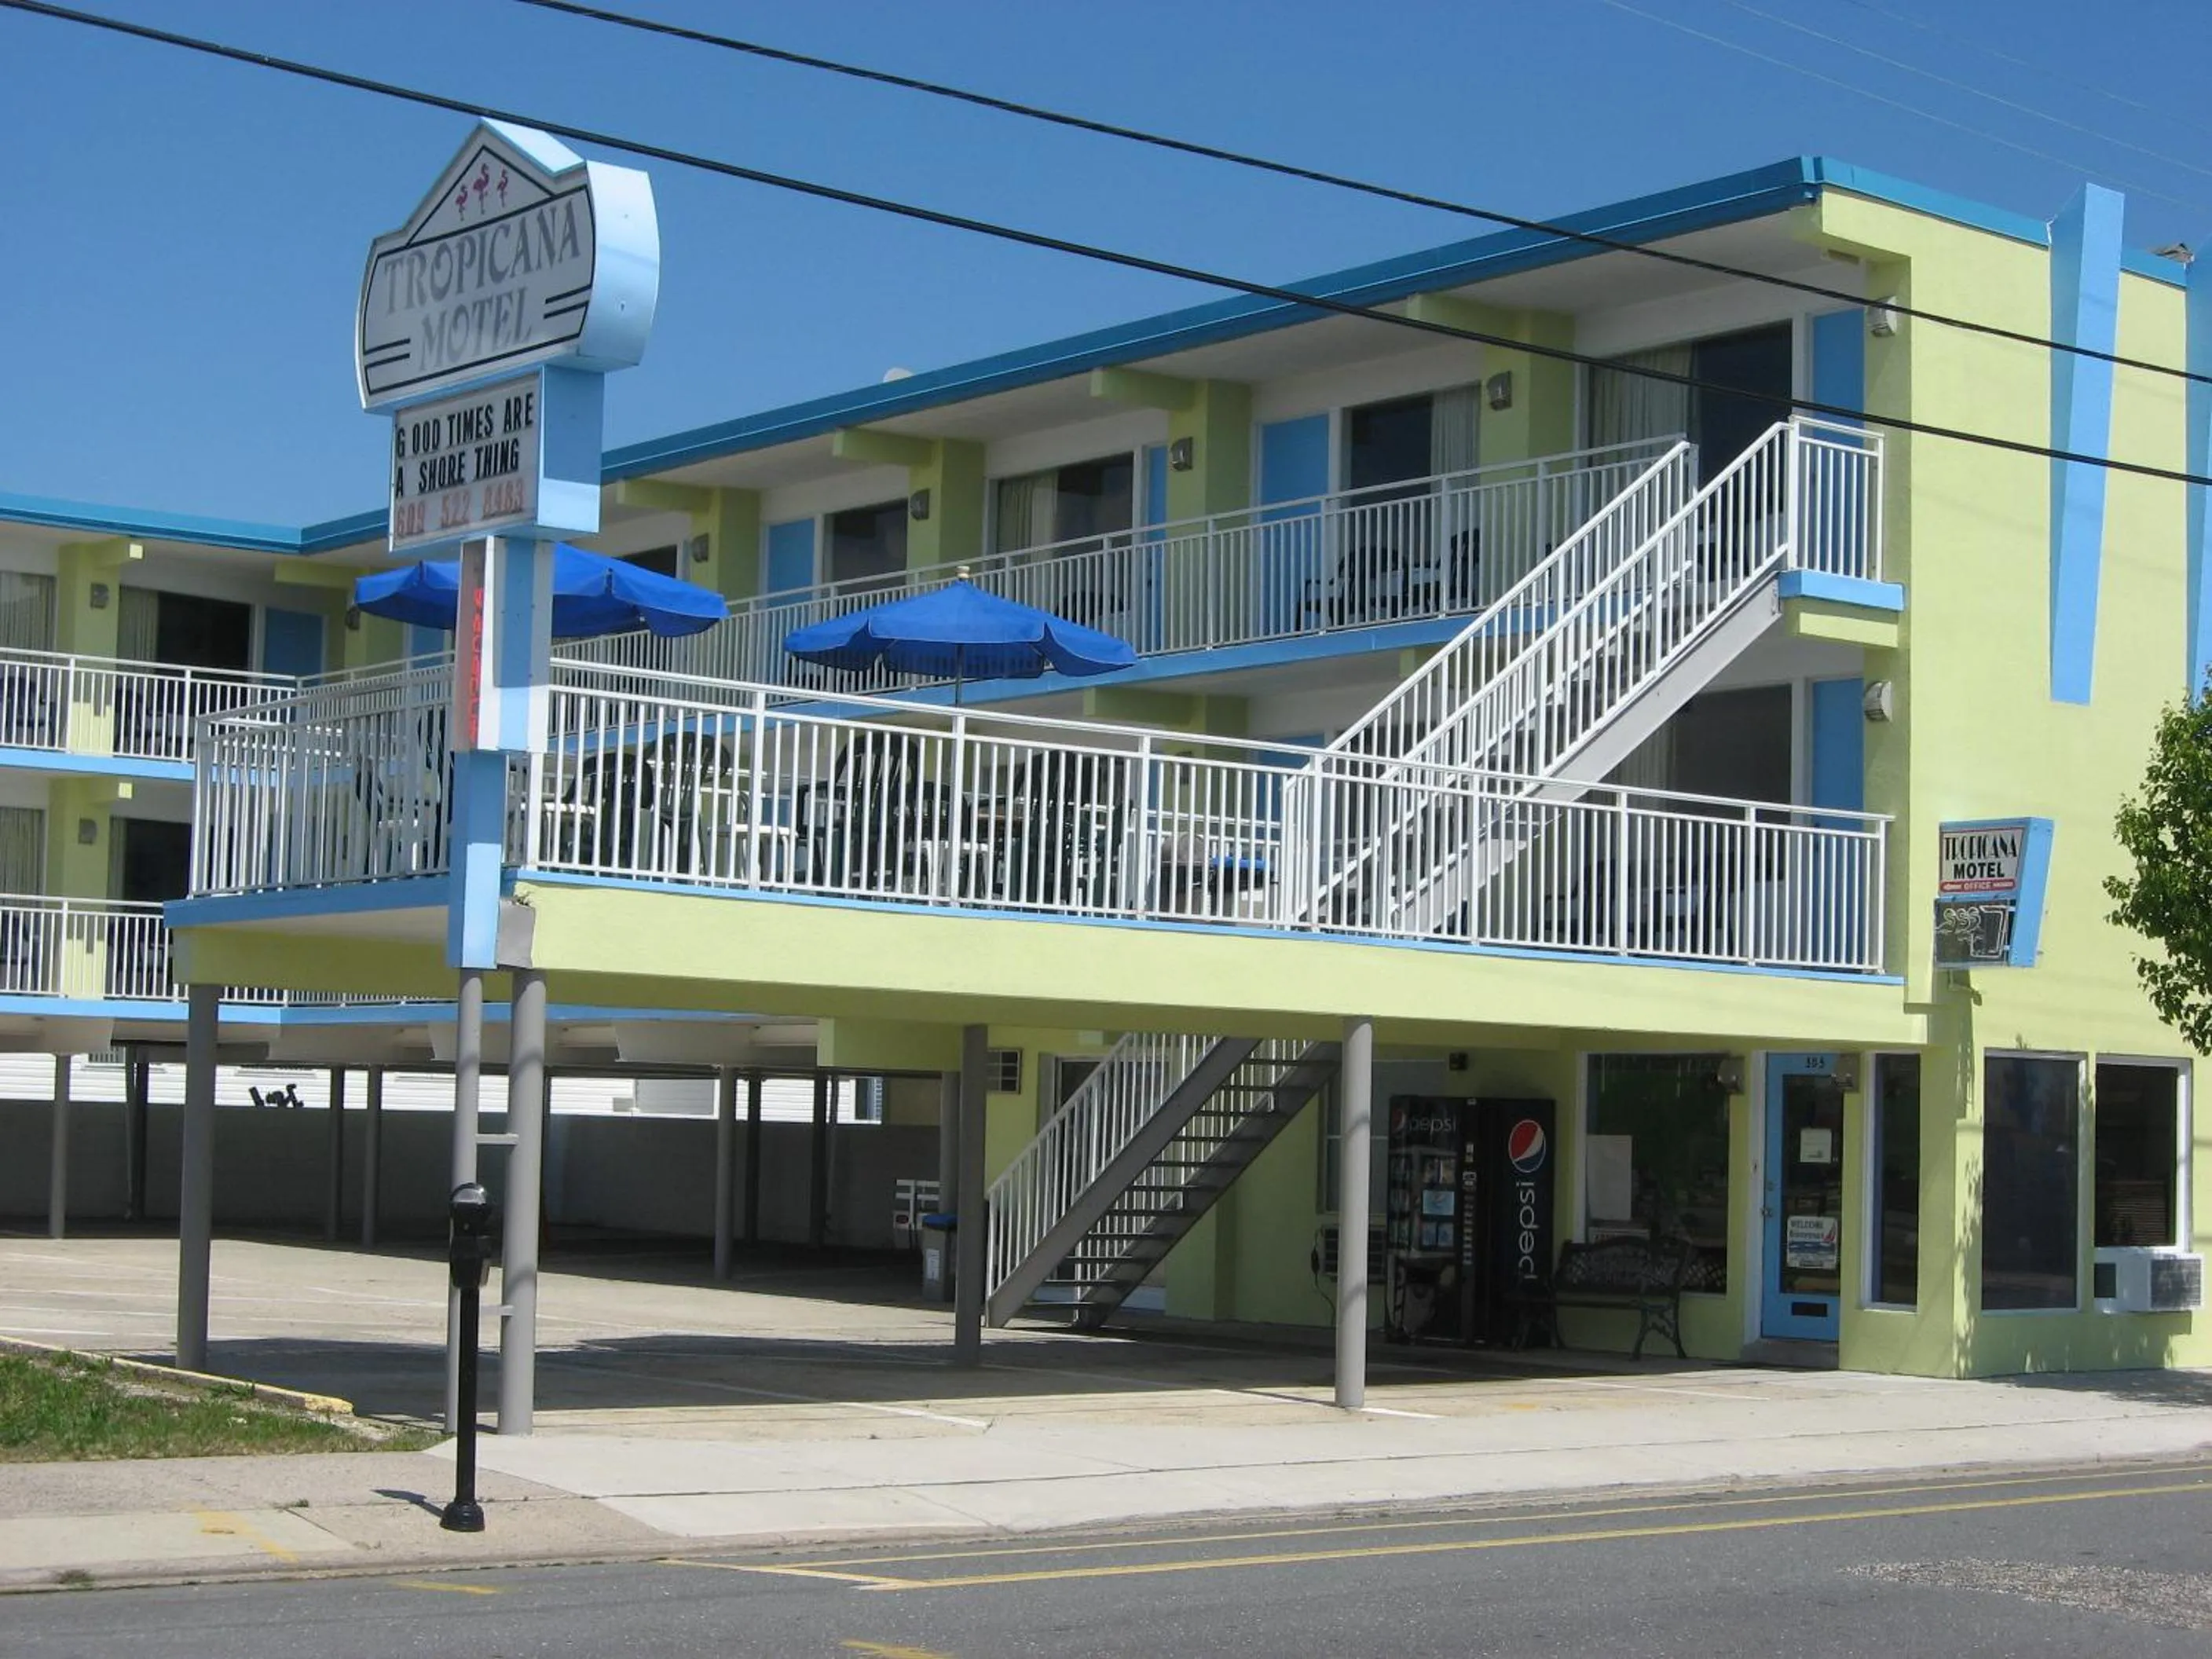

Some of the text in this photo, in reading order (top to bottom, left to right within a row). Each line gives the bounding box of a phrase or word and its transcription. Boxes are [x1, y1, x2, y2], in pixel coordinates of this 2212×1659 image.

[384, 198, 581, 315] TROPICANA
[419, 286, 532, 372] MOTEL
[446, 403, 494, 449] TIMES
[504, 391, 534, 434] ARE
[395, 438, 519, 499] A SHORE THING
[1944, 833, 2017, 861] TROPICANA
[1953, 862, 2005, 880] MOTEL
[1963, 881, 1991, 891] OFFICE
[1408, 1114, 1456, 1141] pepsi
[1515, 1181, 1540, 1280] pepsi
